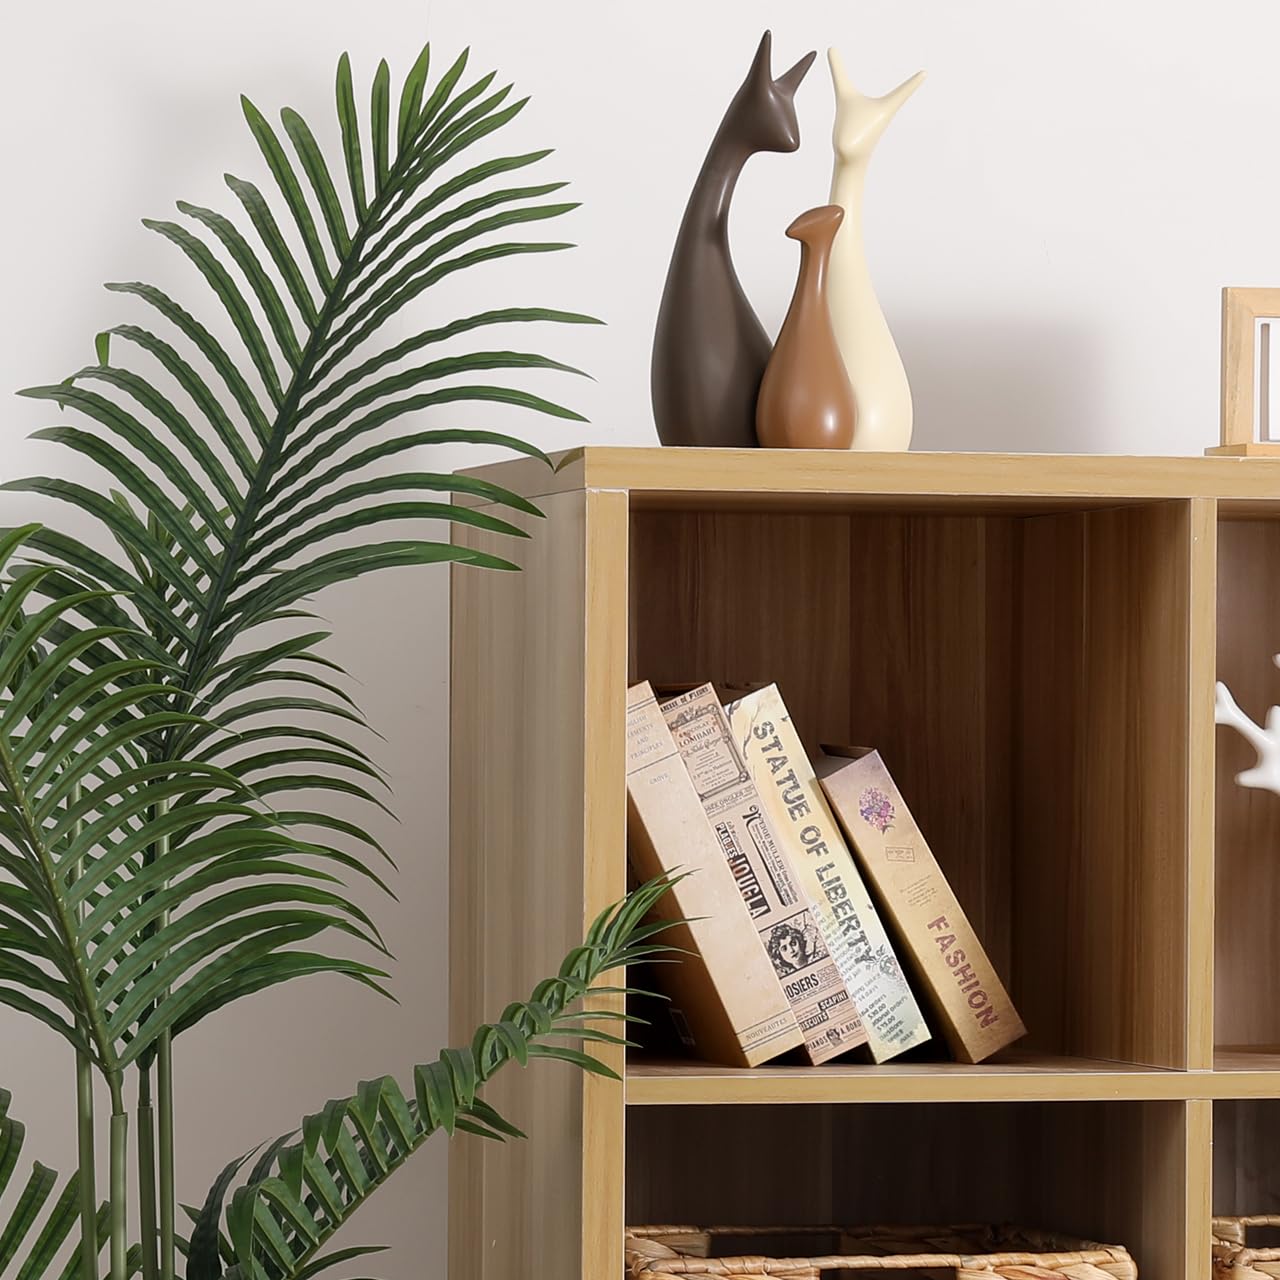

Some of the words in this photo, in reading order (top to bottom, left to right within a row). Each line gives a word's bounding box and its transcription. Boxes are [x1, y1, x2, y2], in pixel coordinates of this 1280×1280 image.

[752, 721, 810, 822] STATUE
[715, 821, 738, 858] PLAQUES
[799, 823, 830, 857] OF
[728, 855, 769, 919] JOUGLA
[814, 863, 874, 965] LIBERTY
[927, 915, 1000, 1031] FASHION
